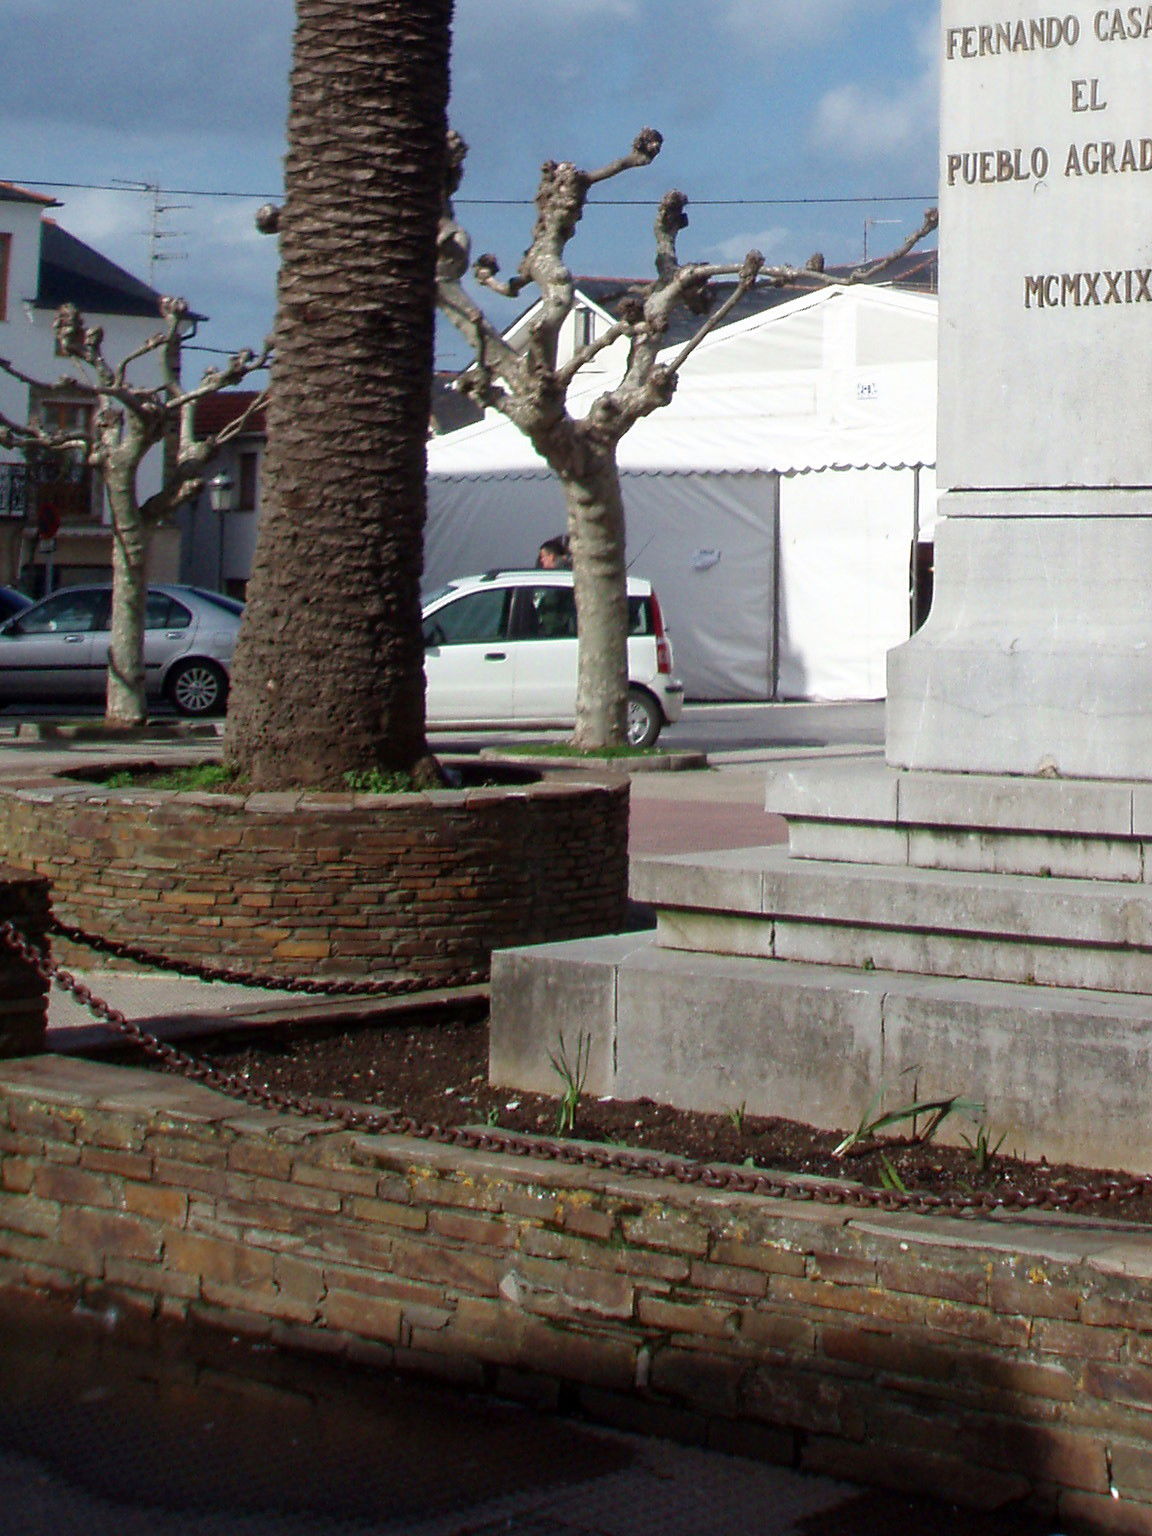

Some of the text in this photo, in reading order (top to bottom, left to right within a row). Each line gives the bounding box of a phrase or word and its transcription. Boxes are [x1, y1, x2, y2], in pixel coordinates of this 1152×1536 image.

[946, 15, 1080, 60] FERNANDO
[1071, 79, 1107, 113] EL
[946, 146, 1048, 186] PUEBLO
